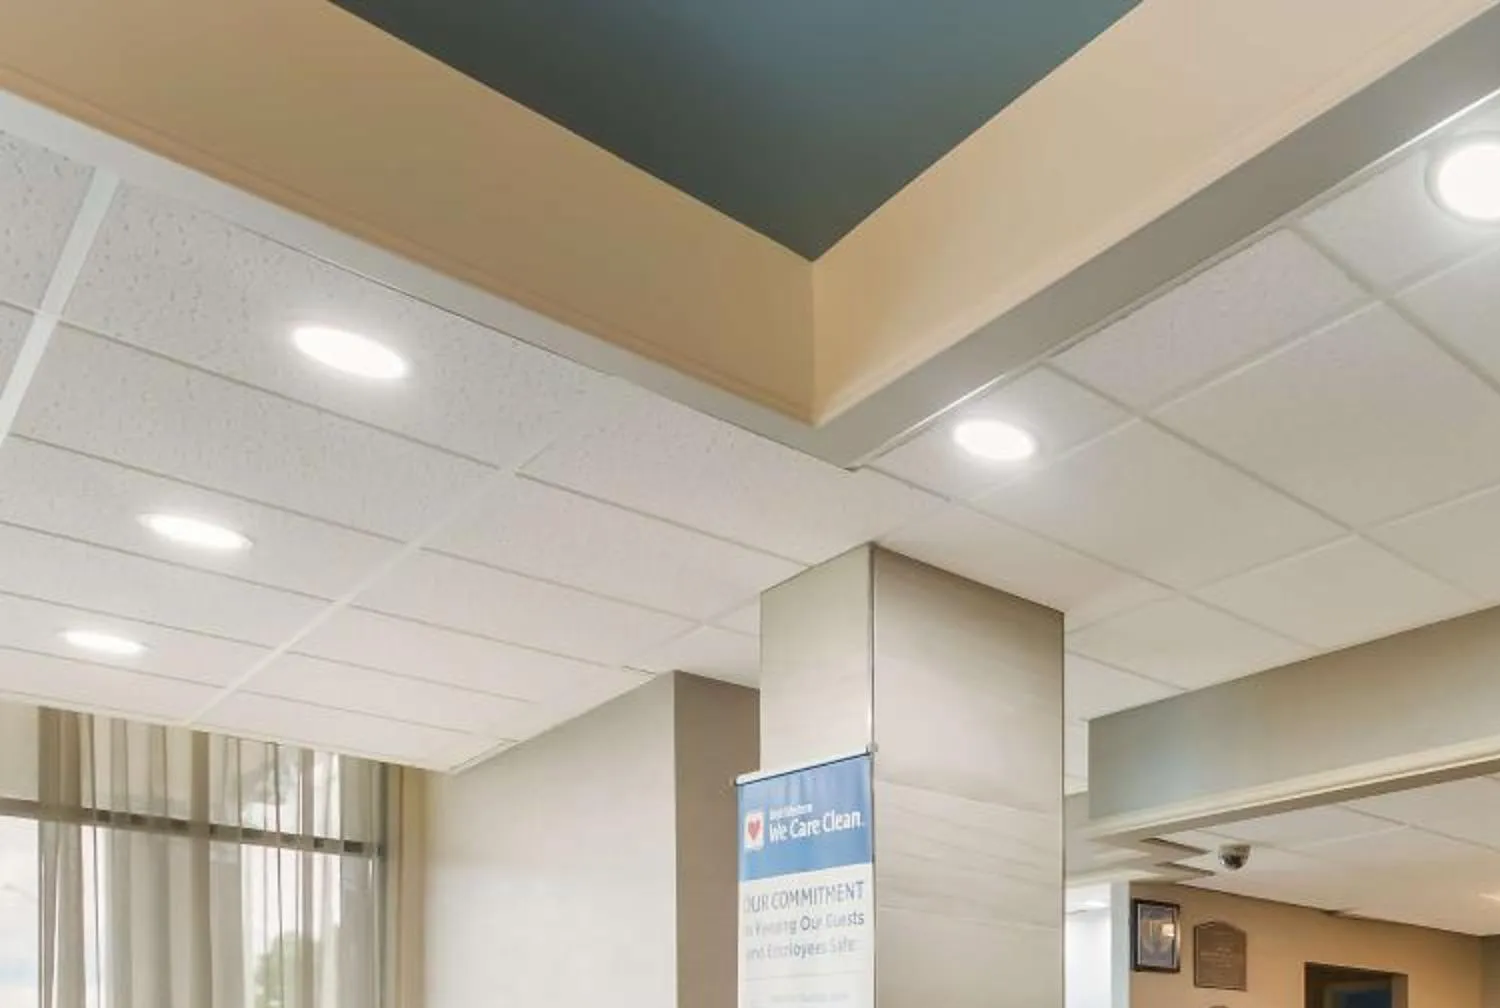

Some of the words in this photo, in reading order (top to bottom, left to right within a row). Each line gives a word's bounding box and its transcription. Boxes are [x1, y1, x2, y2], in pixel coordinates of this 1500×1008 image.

[769, 822, 787, 843] We
[790, 817, 821, 839] Care
[771, 880, 864, 910] COMMITMENT
